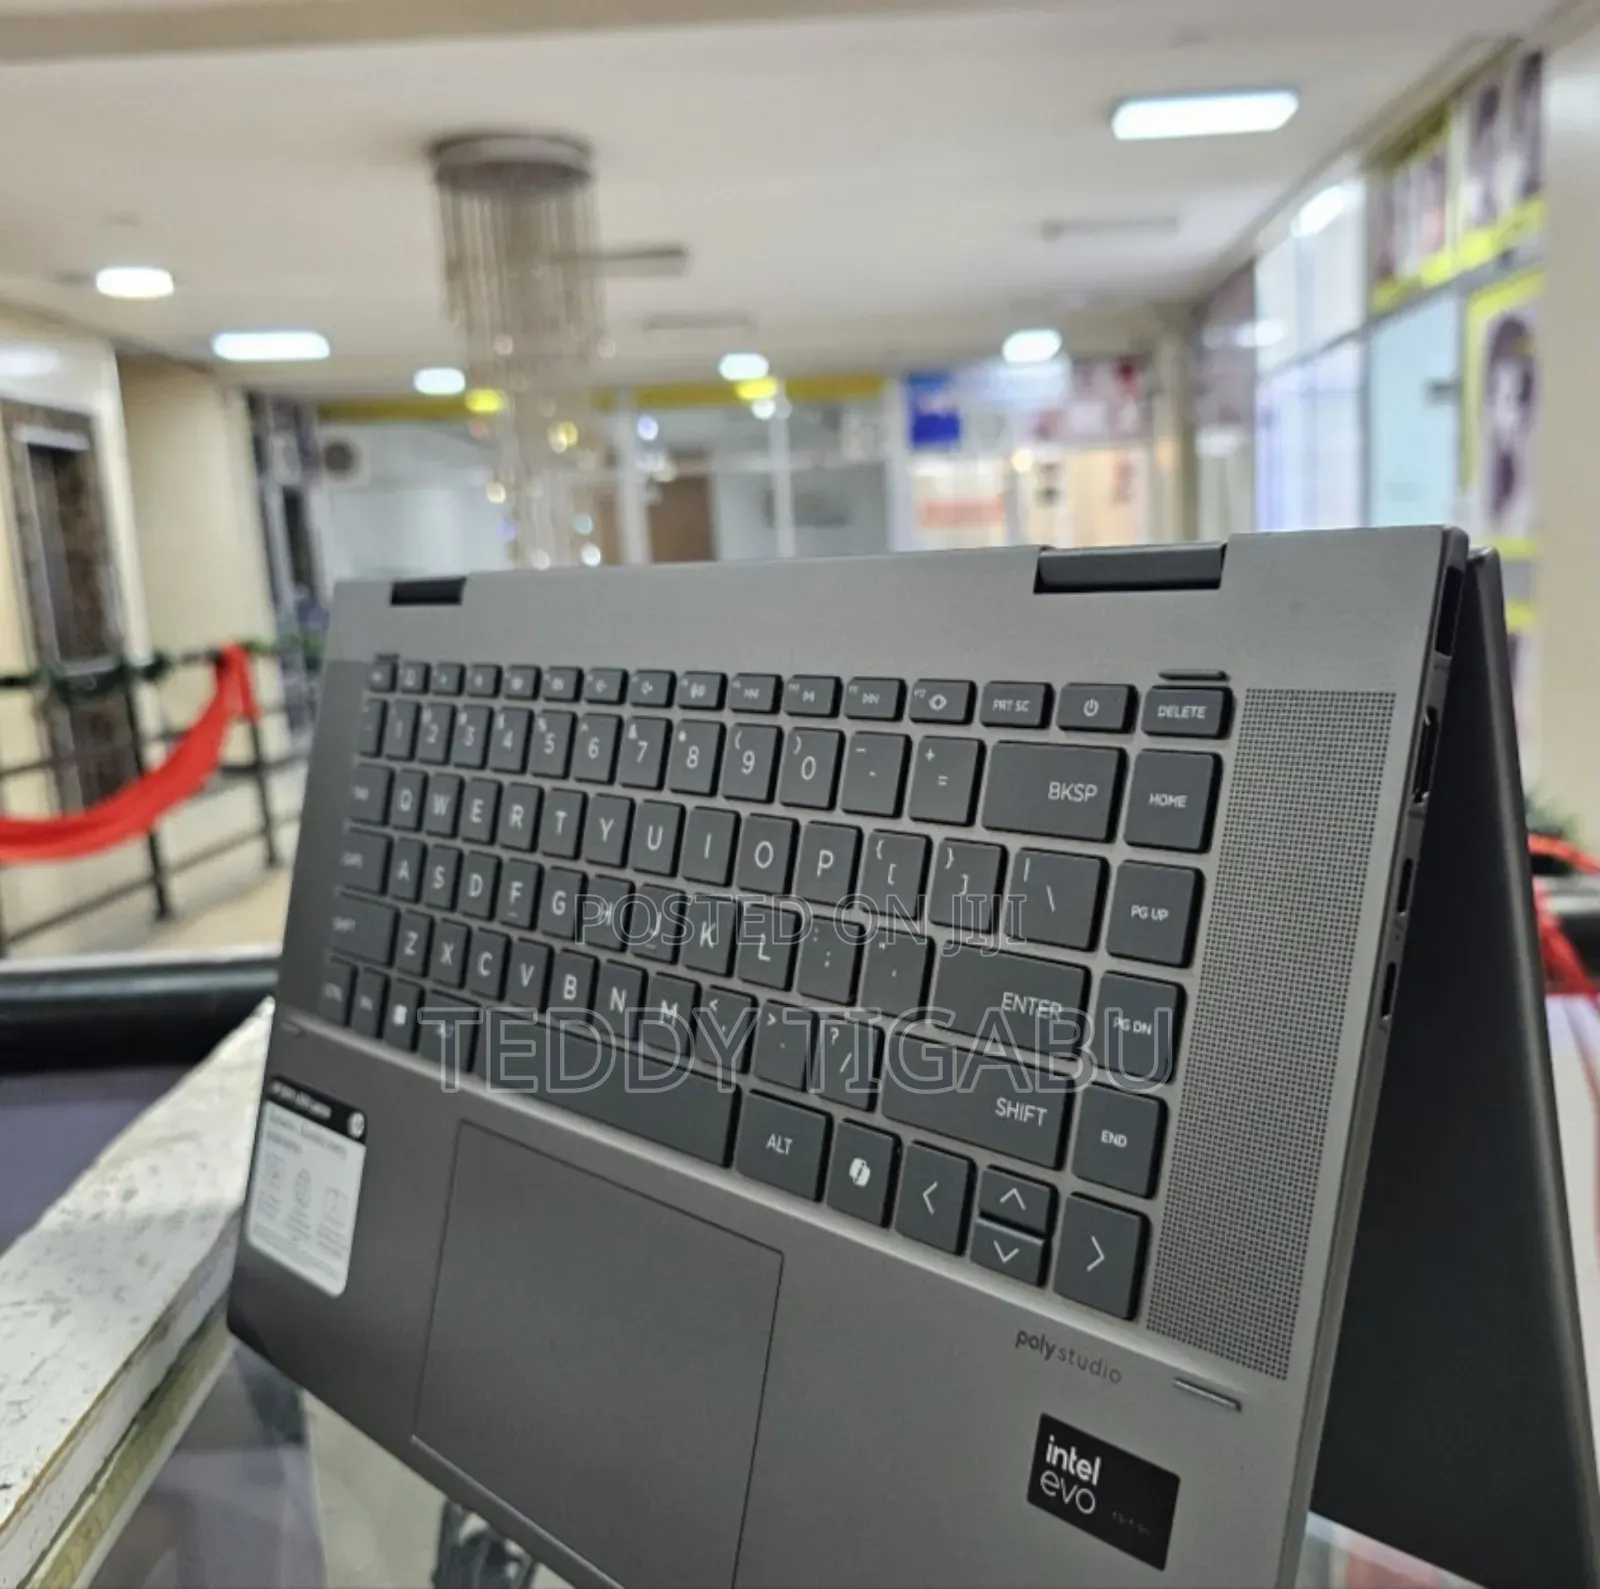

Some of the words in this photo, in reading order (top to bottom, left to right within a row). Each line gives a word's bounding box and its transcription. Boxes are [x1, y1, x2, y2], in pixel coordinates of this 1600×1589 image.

[992, 698, 1014, 711] PRT
[1014, 699, 1030, 713] SC
[1157, 704, 1207, 719] DELETE
[587, 736, 600, 759] 6
[636, 740, 649, 764] 7
[686, 745, 700, 769] 8
[740, 749, 756, 776] 9
[800, 755, 817, 781] 0
[399, 788, 413, 812] Q
[1047, 781, 1098, 803] BKSP
[1148, 793, 1187, 808] HOME
[433, 794, 449, 816] W
[470, 798, 484, 824] E
[510, 804, 524, 828] R
[555, 810, 567, 834] T
[599, 817, 614, 842] Y
[647, 825, 663, 851] U
[754, 840, 774, 869] O
[816, 849, 834, 877] P
[397, 860, 409, 880] A
[432, 865, 445, 890] S
[468, 873, 483, 898] D
[510, 881, 523, 903] F
[551, 890, 566, 916] G
[1131, 904, 1149, 920] PG
[1150, 907, 1169, 921] UP
[404, 930, 419, 956] Z
[700, 920, 716, 949] K
[440, 943, 454, 965] X
[757, 933, 772, 962] L
[478, 951, 493, 977] C
[520, 963, 535, 987] V
[563, 974, 577, 1000] B
[609, 985, 628, 1015] N
[1002, 991, 1064, 1021] ENTER
[659, 1000, 679, 1027] M
[1112, 1017, 1131, 1032] PG
[1132, 1021, 1151, 1035] DN
[995, 1096, 1048, 1127] SHIFT
[766, 1133, 793, 1155] ALT
[1100, 1129, 1128, 1148] END
[1046, 1435, 1102, 1486] intel
[1040, 1470, 1096, 1515] evo
